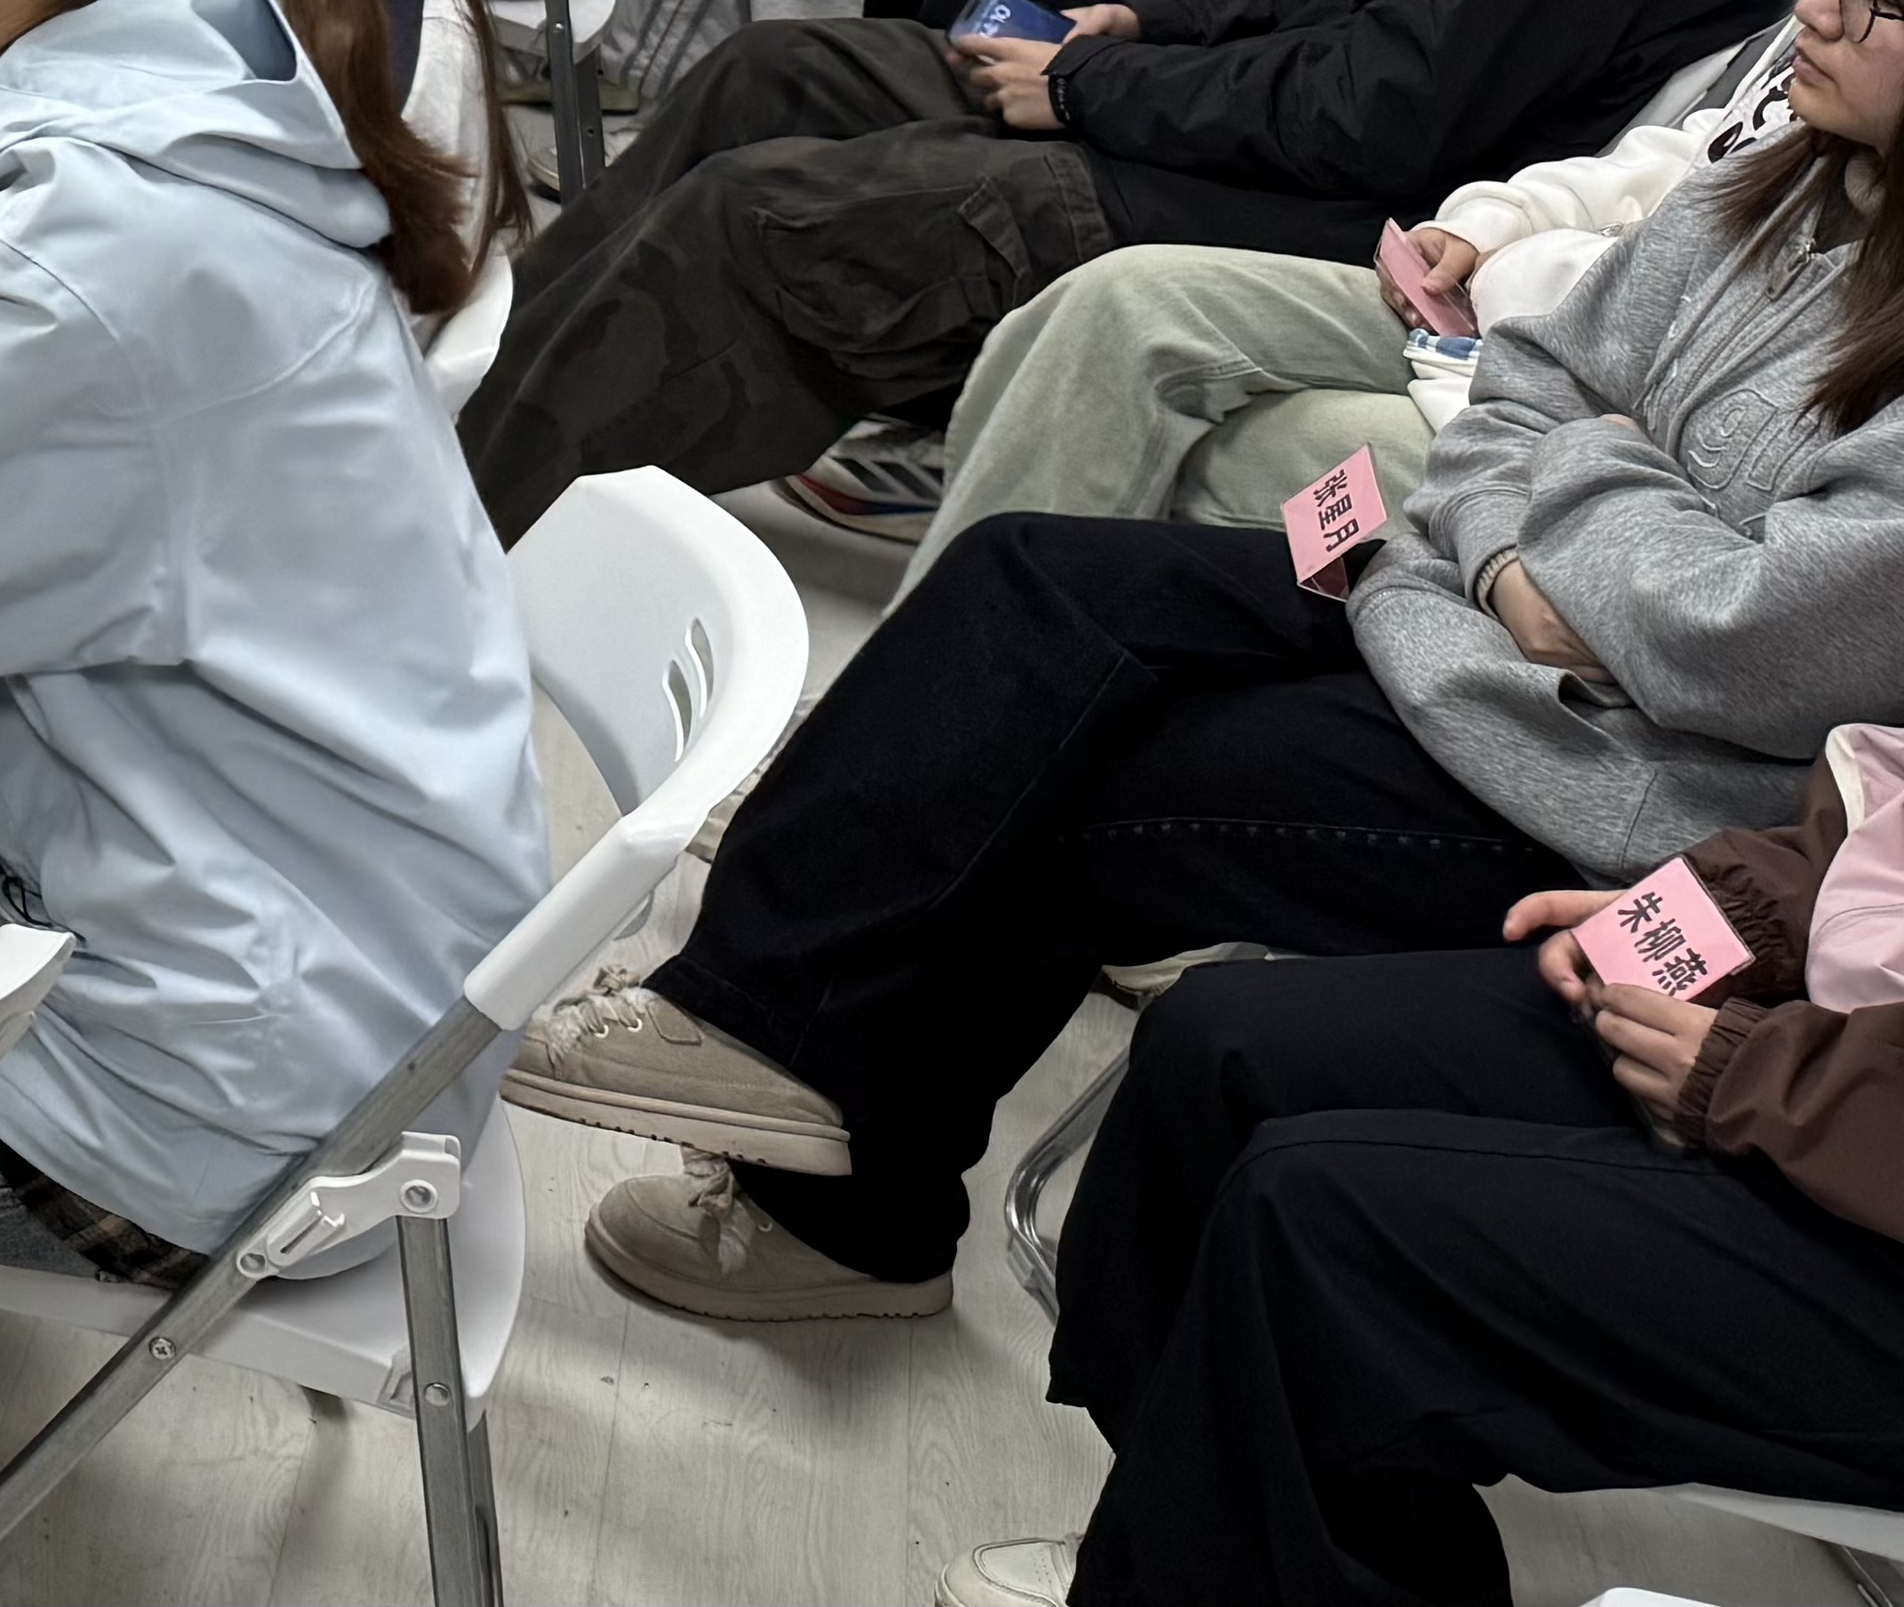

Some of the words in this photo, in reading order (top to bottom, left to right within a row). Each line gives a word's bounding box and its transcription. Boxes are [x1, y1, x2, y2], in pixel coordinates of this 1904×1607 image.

[1313, 468, 1360, 552] 张星月
[1617, 891, 1708, 996] 朱柳燕
